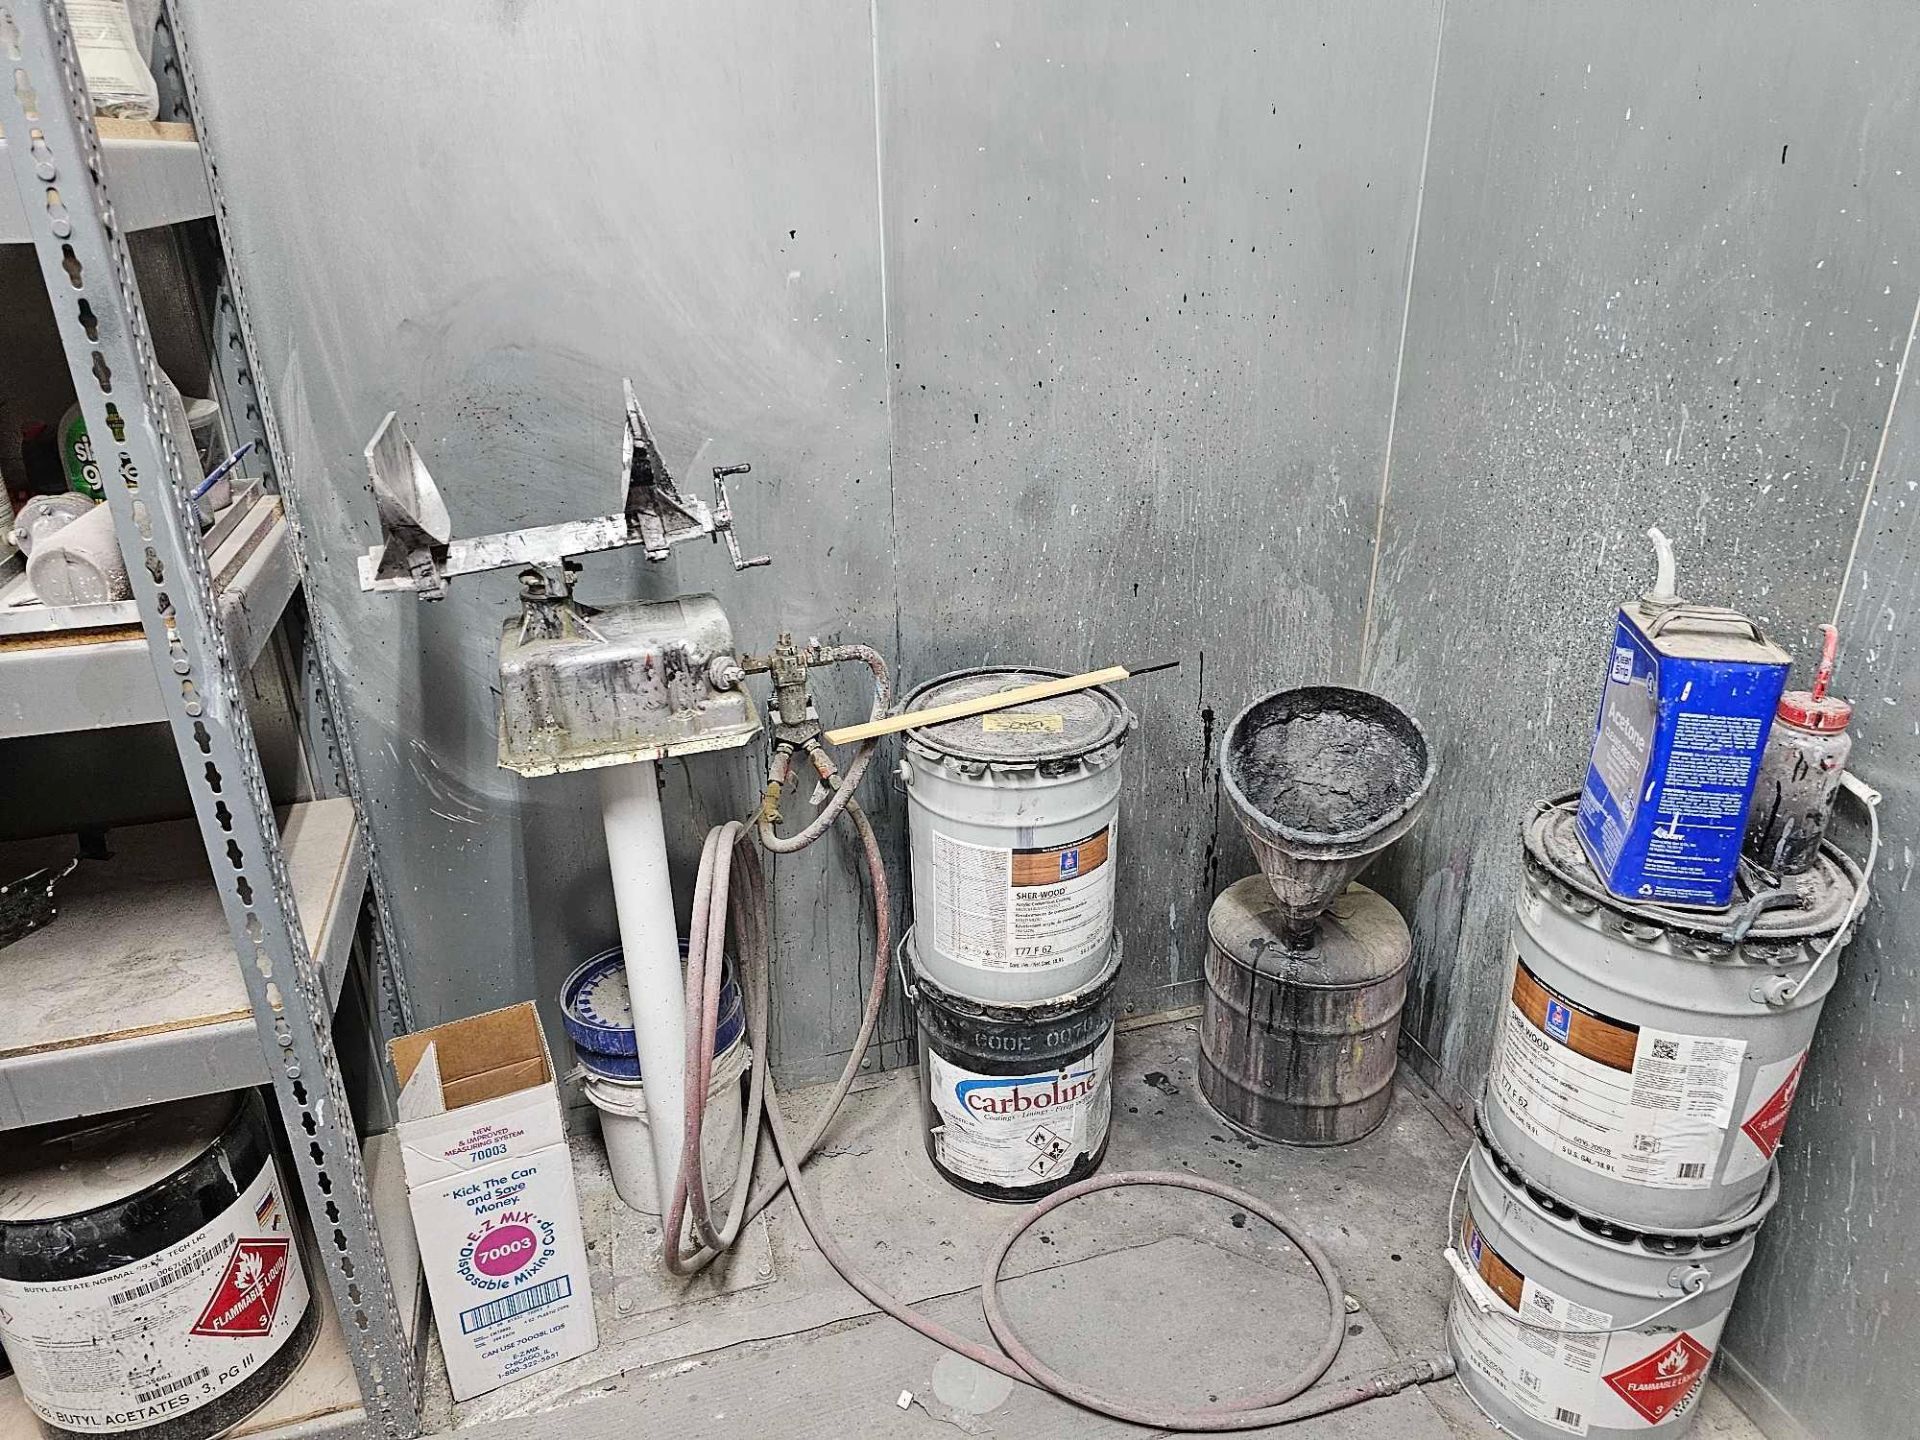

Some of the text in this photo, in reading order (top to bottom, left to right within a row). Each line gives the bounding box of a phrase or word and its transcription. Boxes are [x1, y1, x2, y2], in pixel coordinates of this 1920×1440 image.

[1608, 702, 1646, 753] Acetone
[1016, 888, 1066, 900] SHER-WOOD
[1519, 1096, 1528, 1108] 62
[466, 1127, 509, 1145] IMPROVED
[472, 1125, 492, 1136] NEW
[444, 1130, 524, 1157] MEASURING SYSTEM
[470, 1143, 508, 1162] 70003
[483, 1176, 507, 1189] The
[511, 1167, 537, 1180] Can
[466, 1182, 526, 1206] and Save
[467, 1211, 534, 1241] E-Z MIX
[457, 1221, 556, 1290] Disposable Mixing Cup
[478, 1237, 532, 1264] 70003
[24, 1285, 51, 1294] BUTYL
[51, 1282, 91, 1294] ACETATE
[92, 1269, 136, 1287] NORMAL
[212, 1280, 266, 1330] FLAMMABLE
[264, 1256, 285, 1286] LIQUID
[259, 1314, 268, 1326] 3
[481, 1348, 499, 1360] CAN
[499, 1341, 515, 1352] USE
[57, 1410, 101, 1426] BUTYL
[105, 1393, 190, 1427] ACETATES
[218, 1365, 241, 1385] PG
[242, 1353, 255, 1369] III
[1628, 1380, 1677, 1392] FLAMMABLE
[1655, 1405, 1664, 1415] 3
